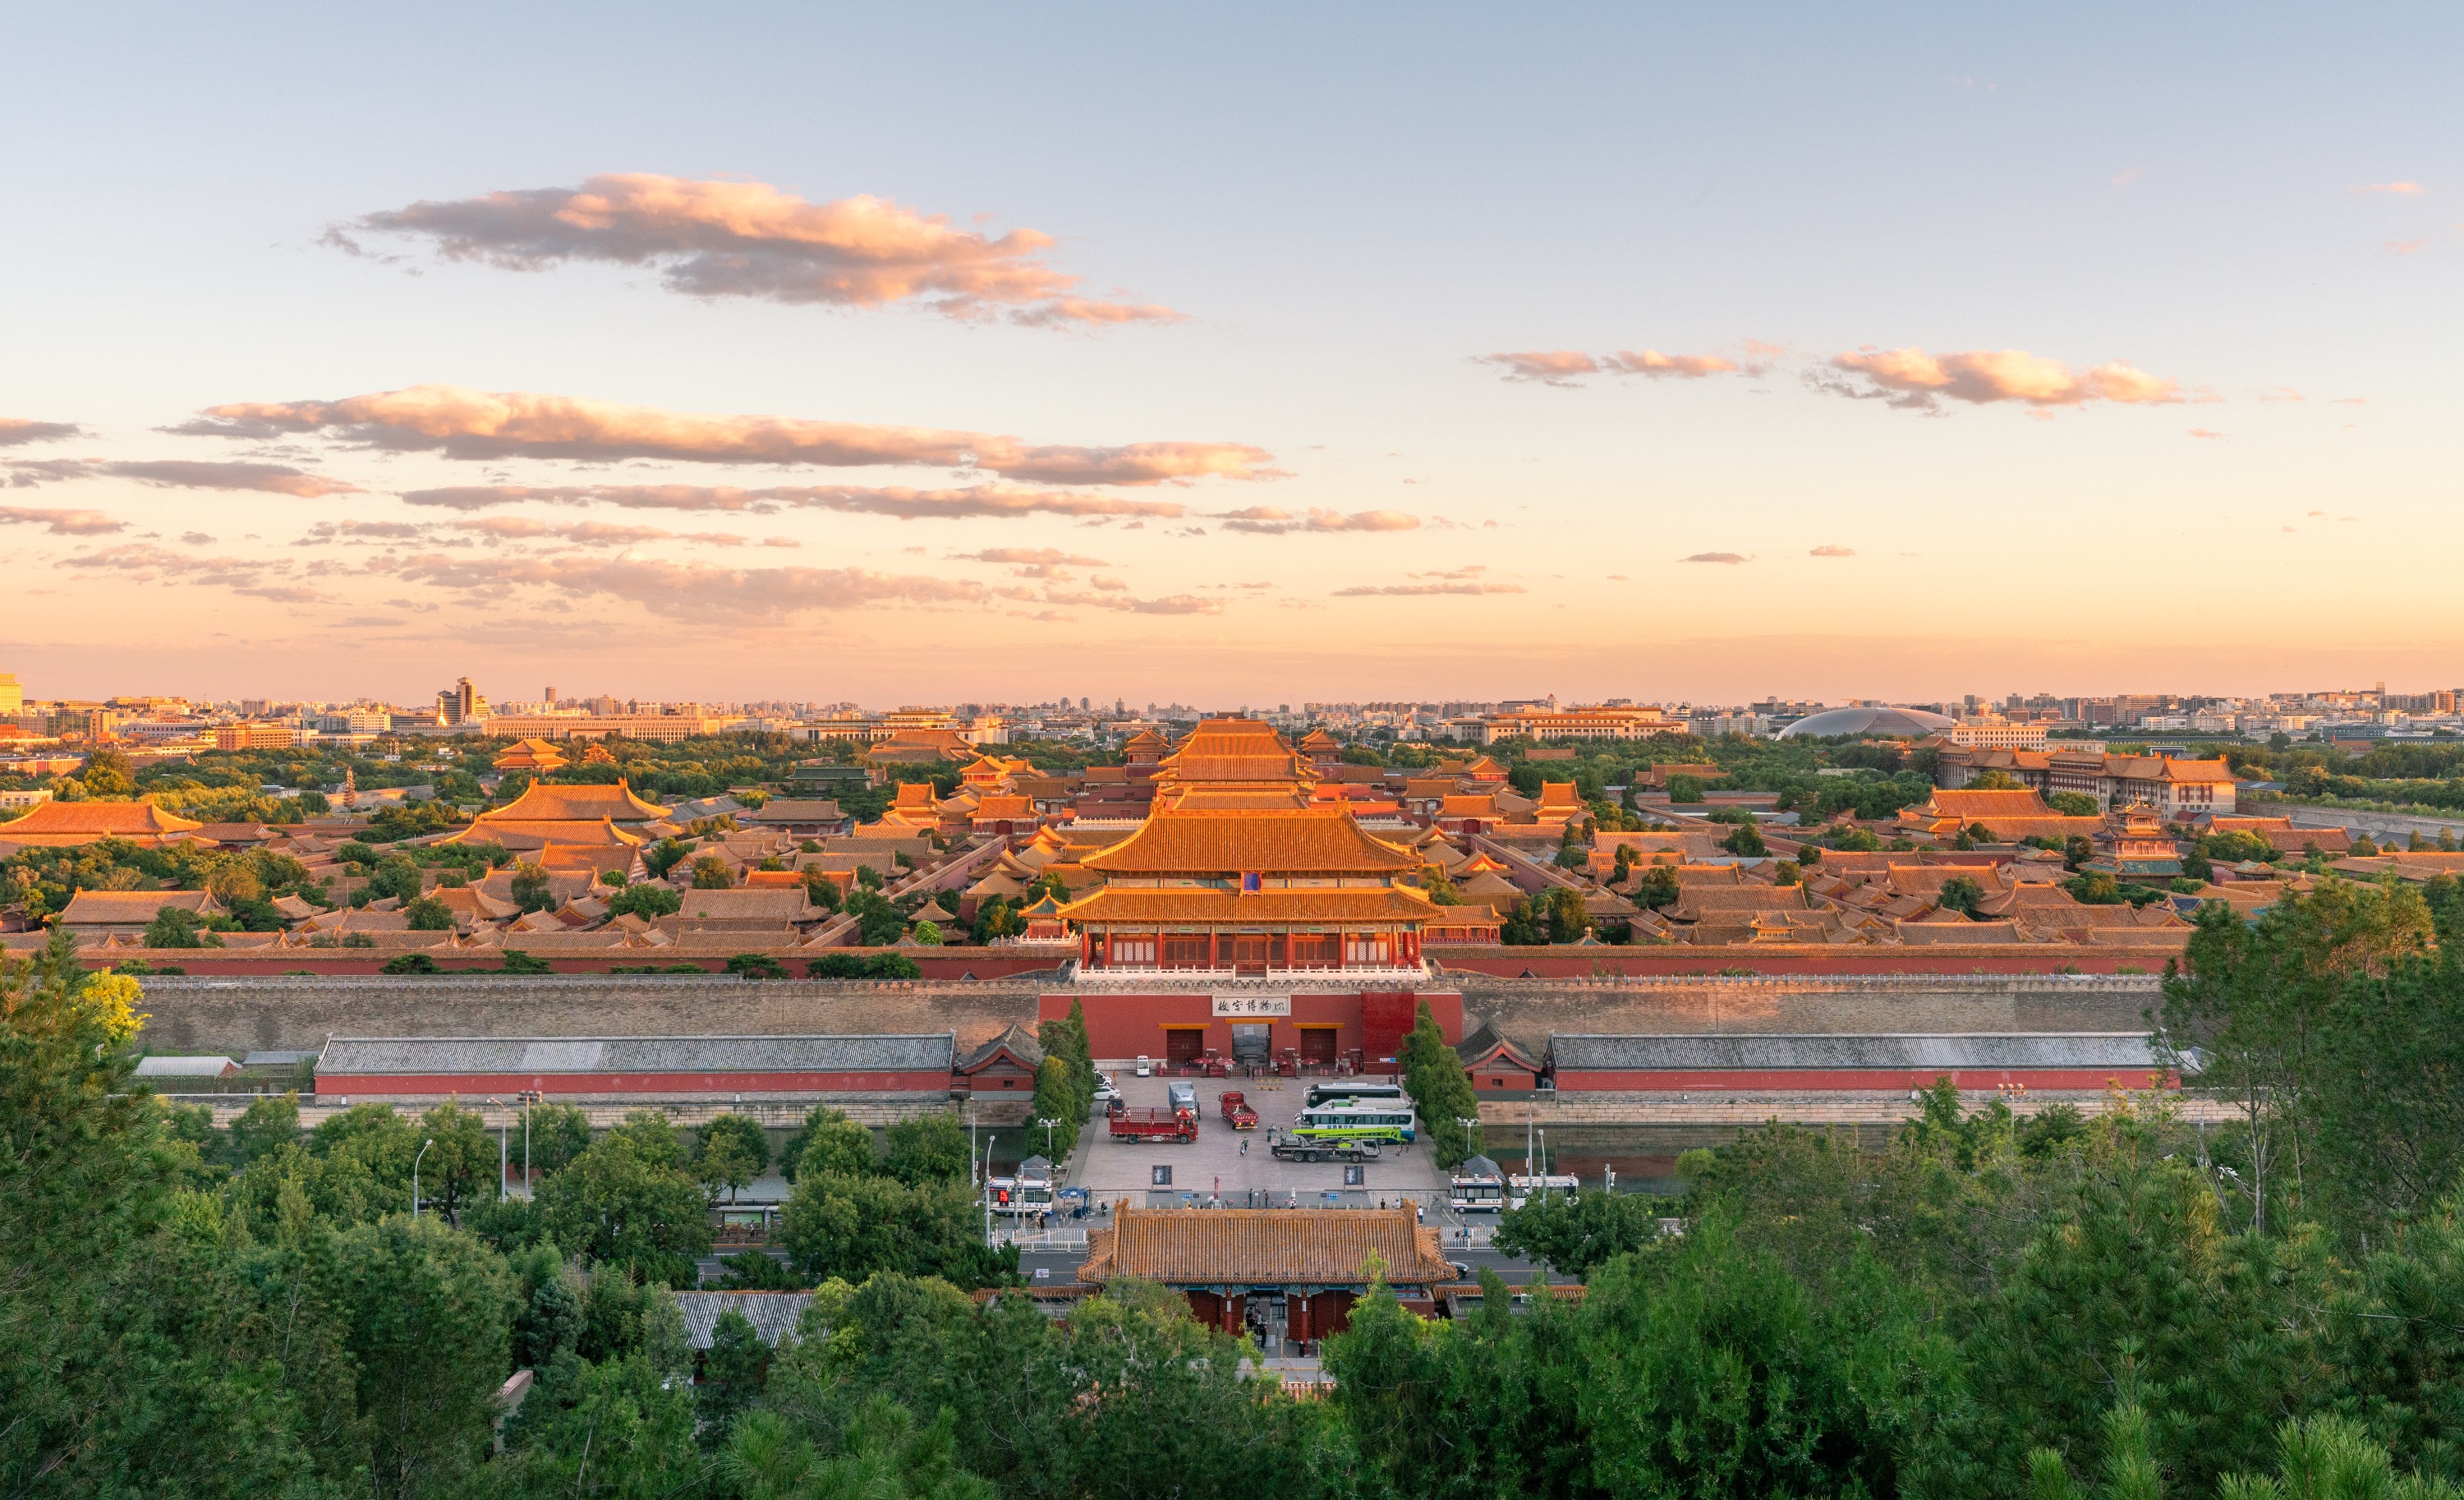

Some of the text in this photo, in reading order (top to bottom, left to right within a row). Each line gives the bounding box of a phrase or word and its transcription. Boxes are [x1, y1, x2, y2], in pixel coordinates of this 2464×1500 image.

[1218, 999, 1285, 1011] 故宫博物院
